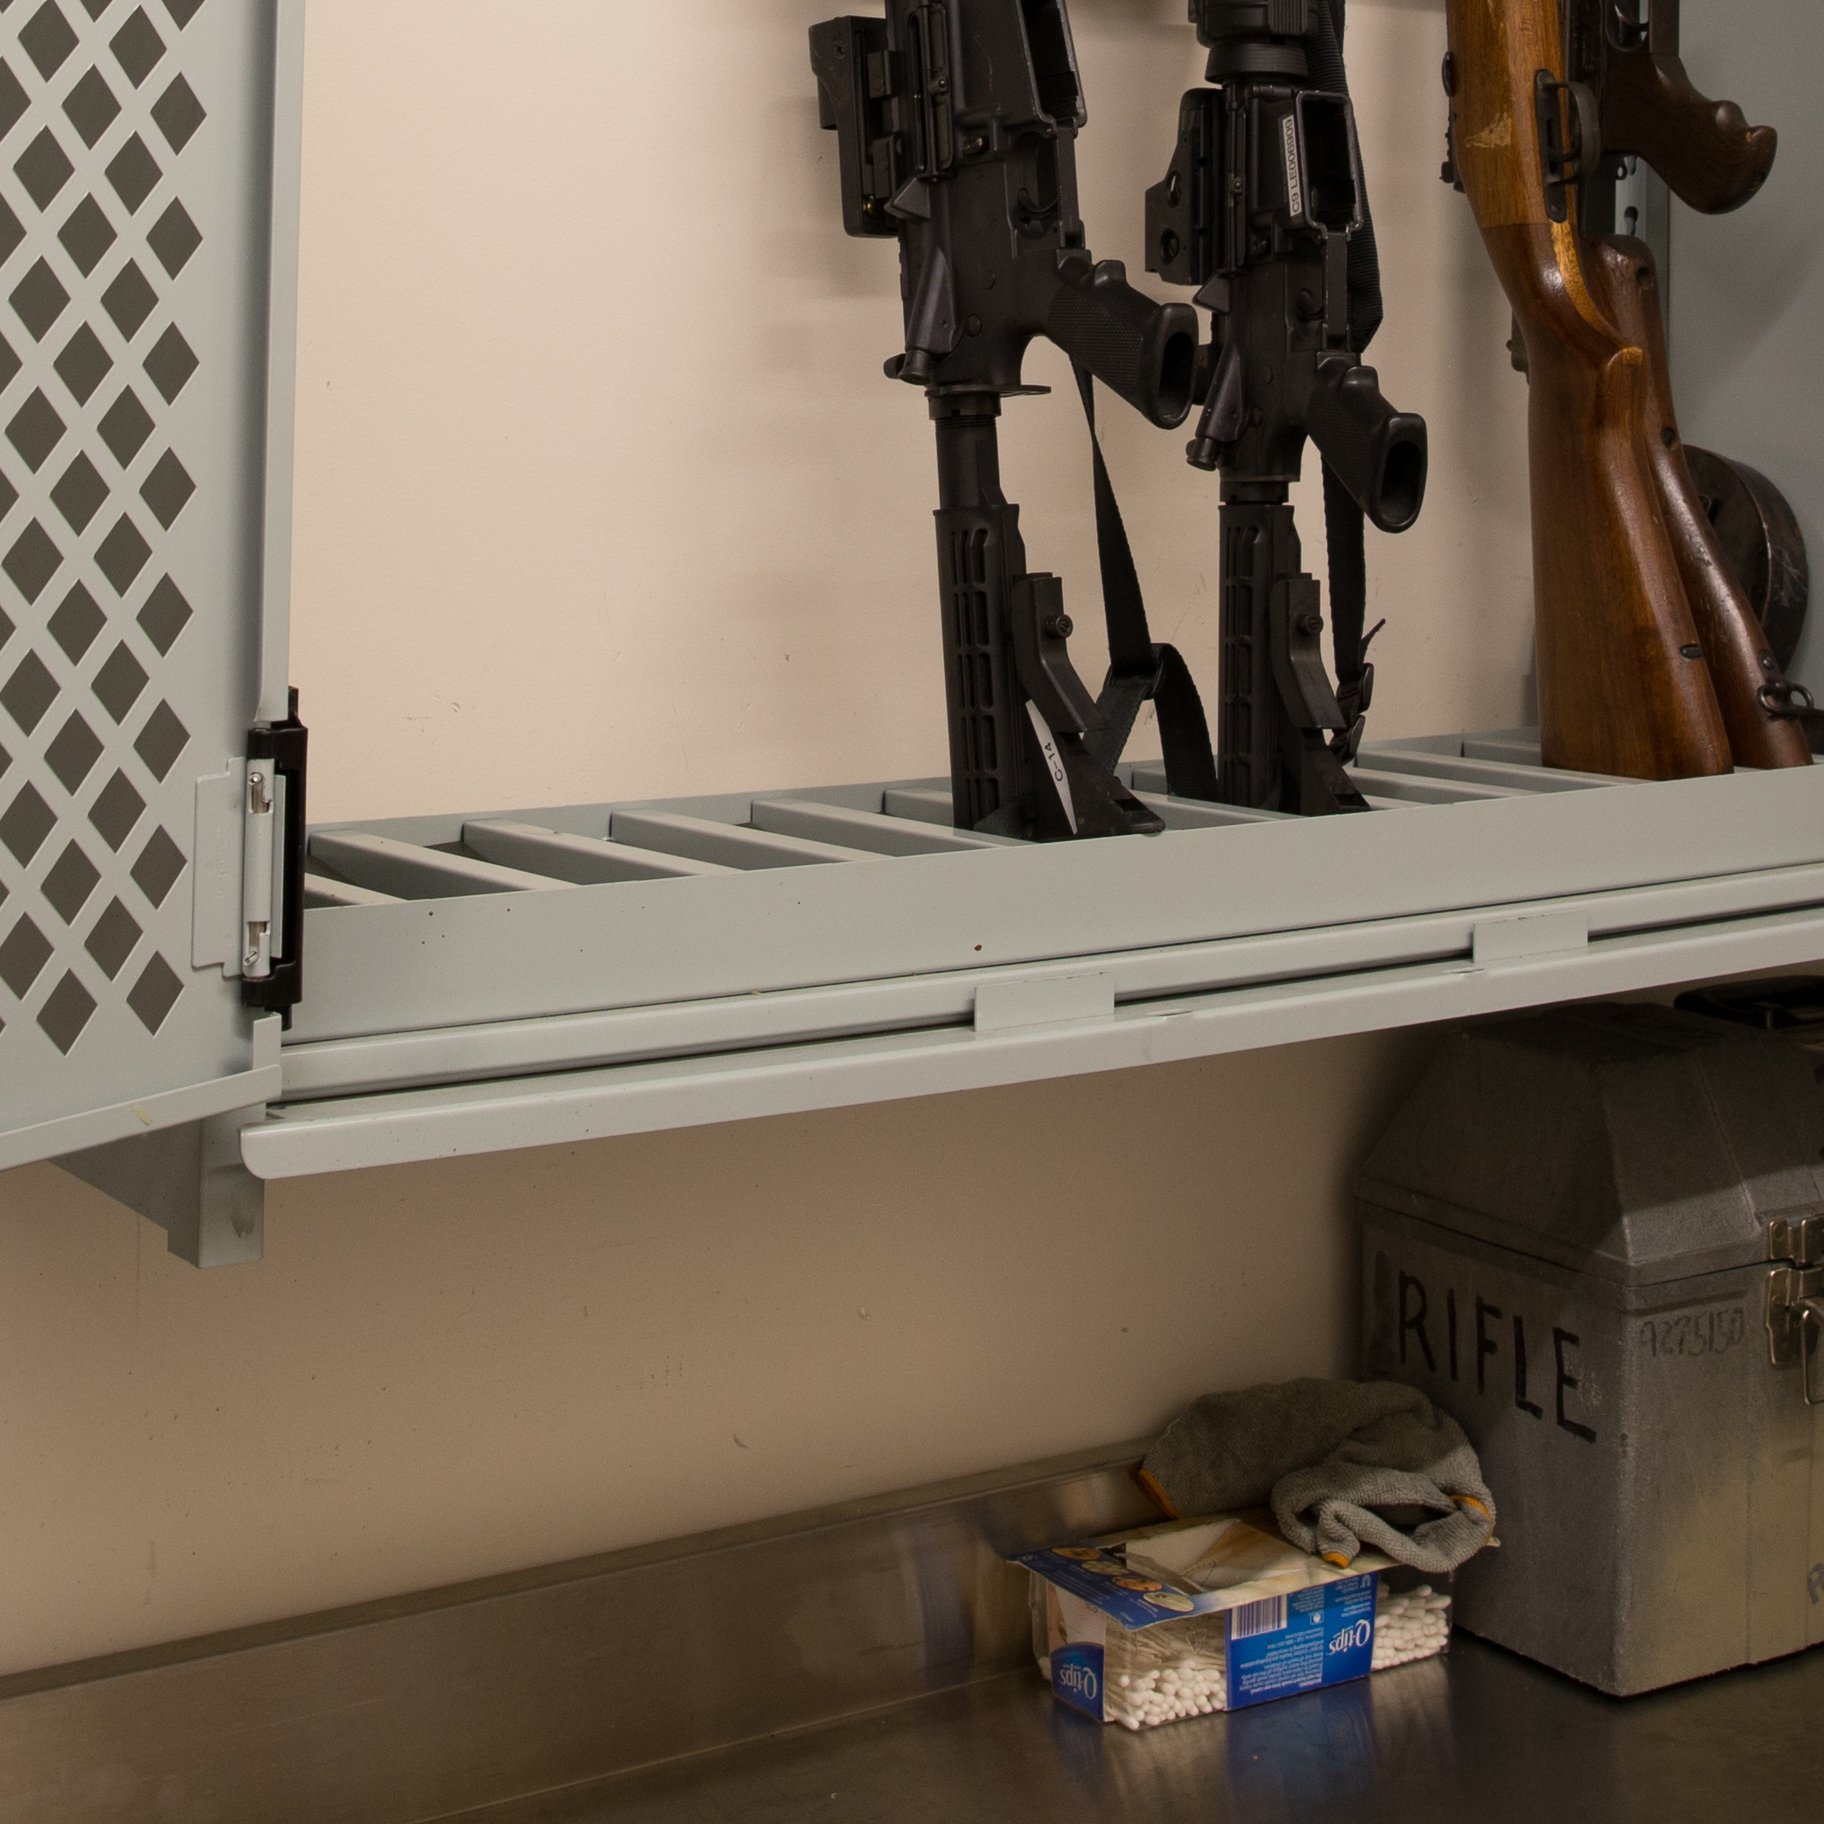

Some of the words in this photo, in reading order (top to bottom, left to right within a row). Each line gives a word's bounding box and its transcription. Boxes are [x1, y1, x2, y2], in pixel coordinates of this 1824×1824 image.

[1291, 192, 1300, 213] C9
[1045, 742, 1064, 782] C-14
[1398, 1269, 1597, 1444] RIFLE
